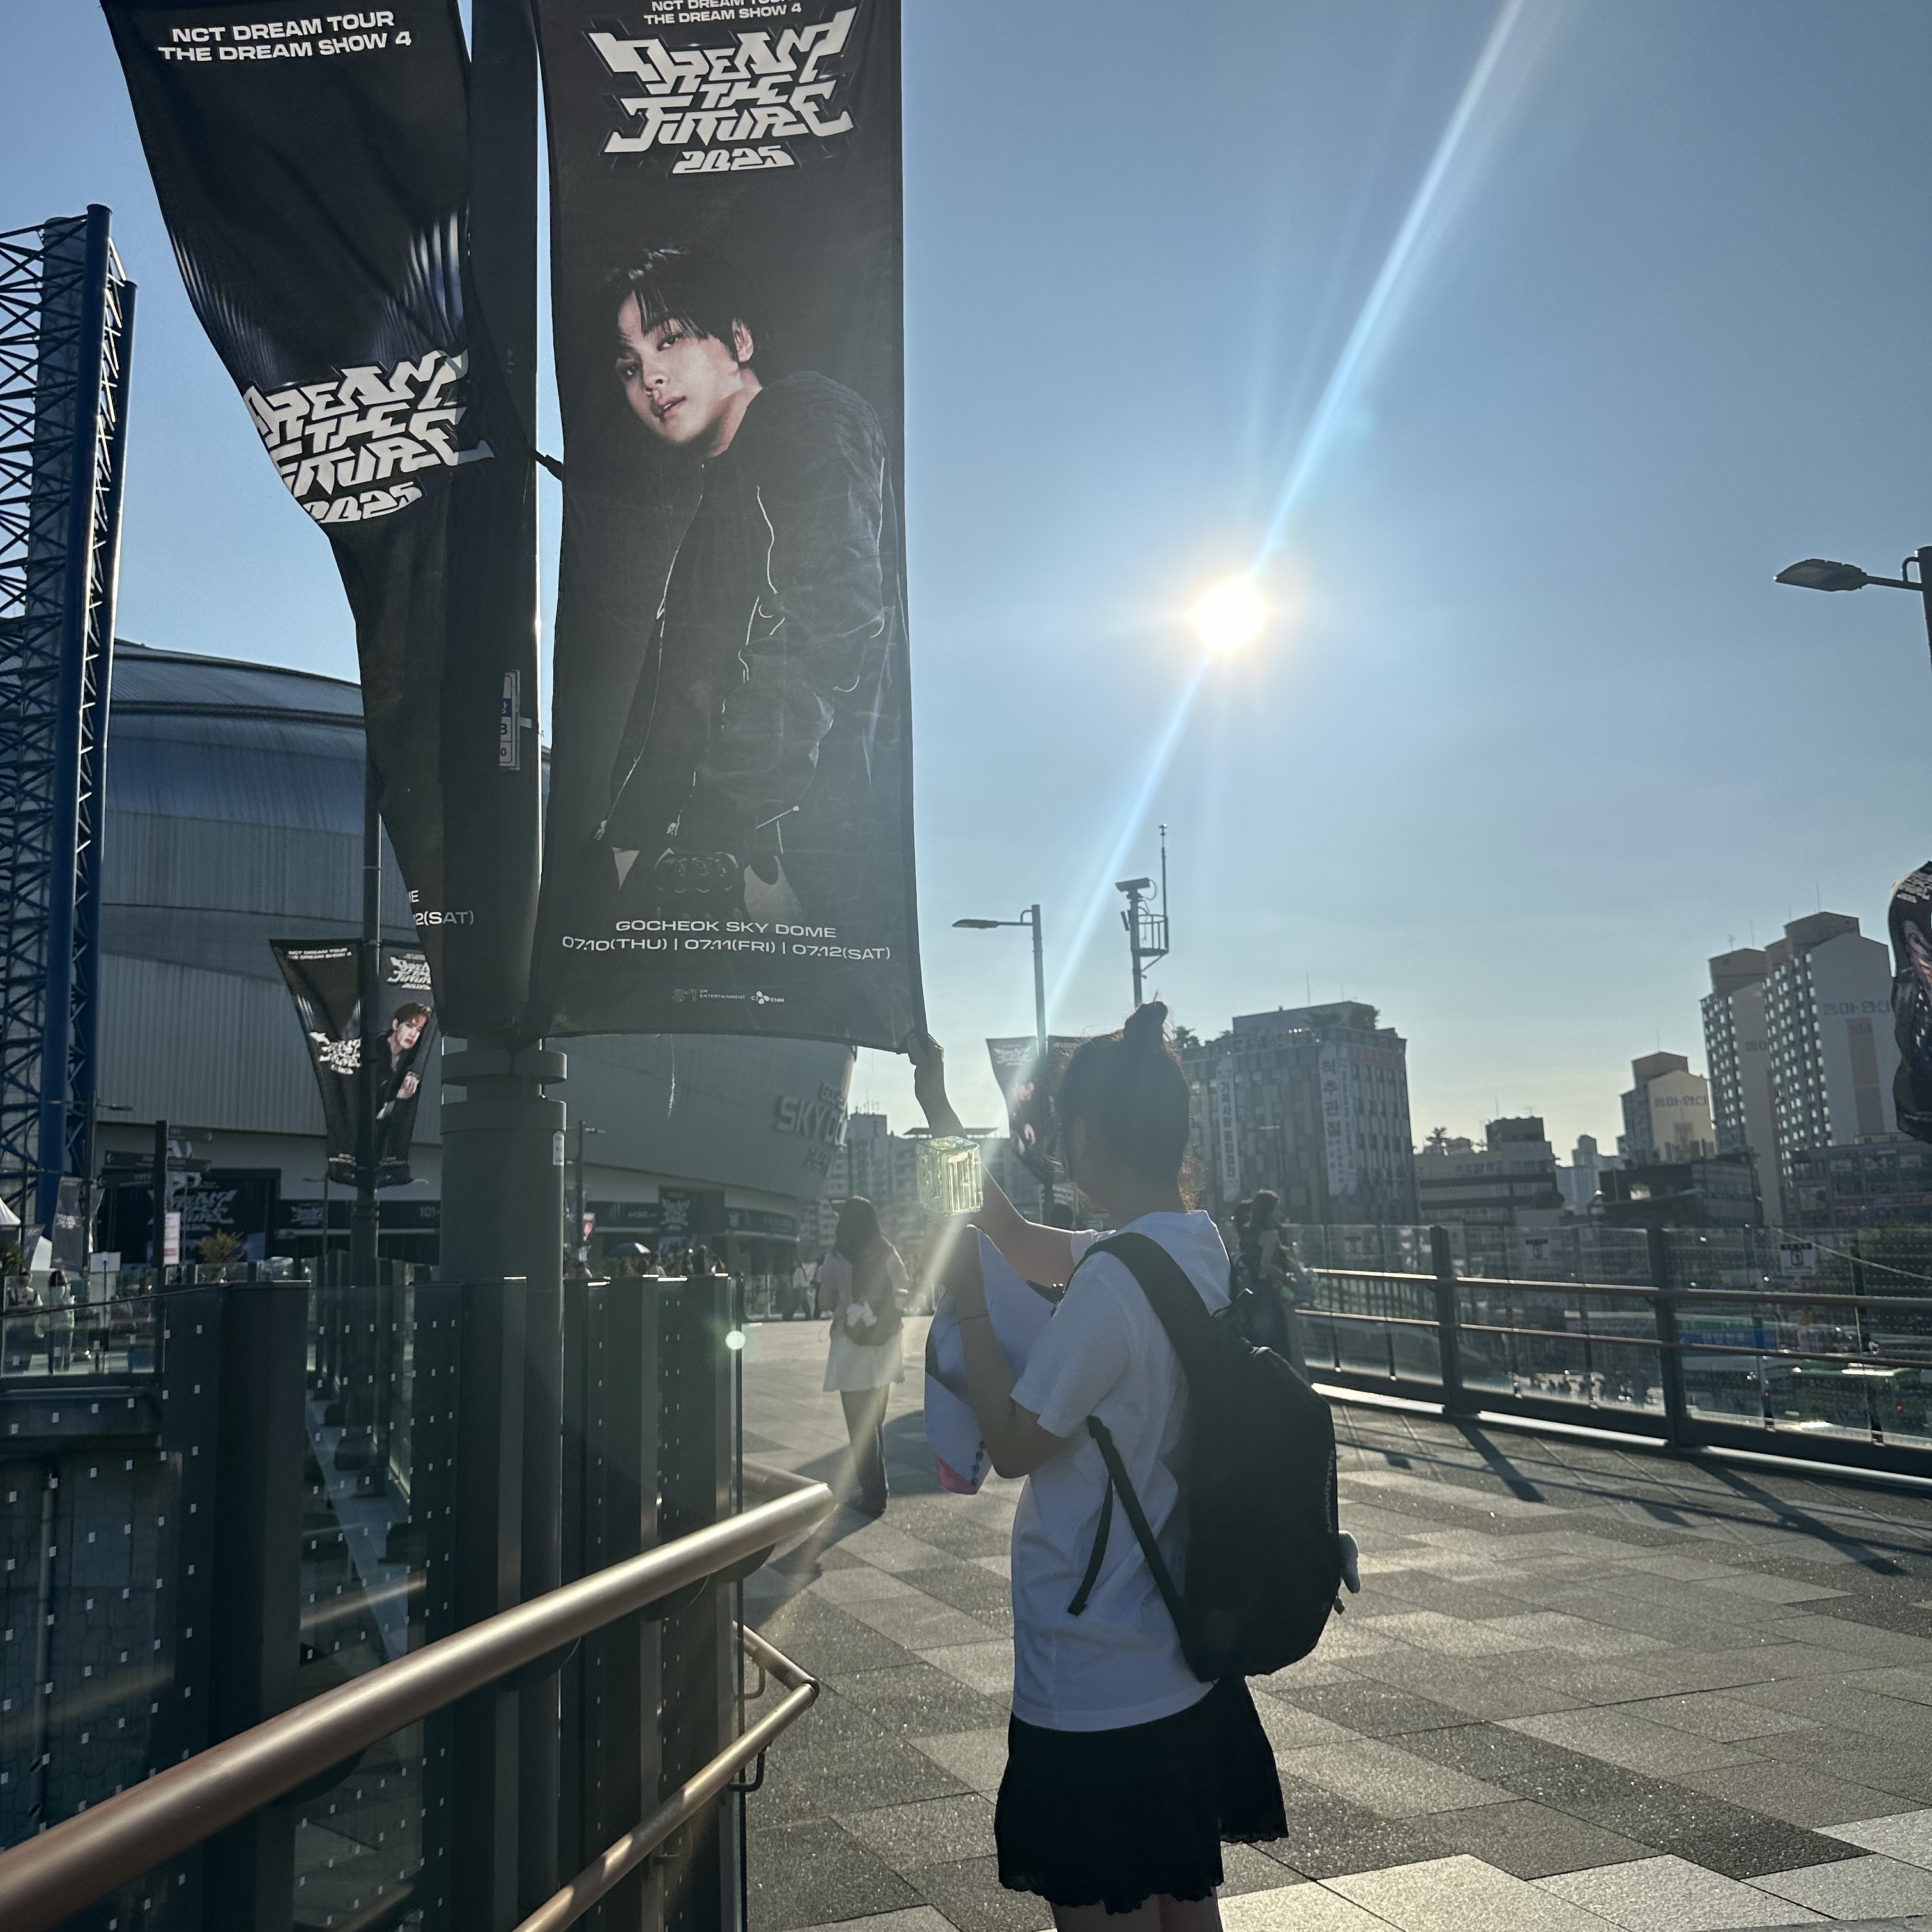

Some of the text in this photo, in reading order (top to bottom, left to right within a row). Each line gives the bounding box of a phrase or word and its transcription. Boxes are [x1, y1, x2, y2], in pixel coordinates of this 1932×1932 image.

[643, 14, 675, 25] THE
[678, 10, 735, 23] DREAM
[739, 4, 787, 19] SHOW
[791, 3, 802, 13] 4
[652, 0, 684, 12] NCT
[172, 11, 395, 42] NCT DREAM TOUR
[158, 31, 411, 61] THE DREAM SHOW 4
[588, 7, 857, 94] DREAM
[672, 145, 794, 174] 2025
[615, 920, 837, 939] GOCHEOK SKY DOME
[562, 936, 668, 951] 07.10(THU)
[684, 939, 776, 953] 07.11(FRI)
[792, 944, 891, 960] 07.12(SAT)
[777, 1096, 829, 1138] SKY
